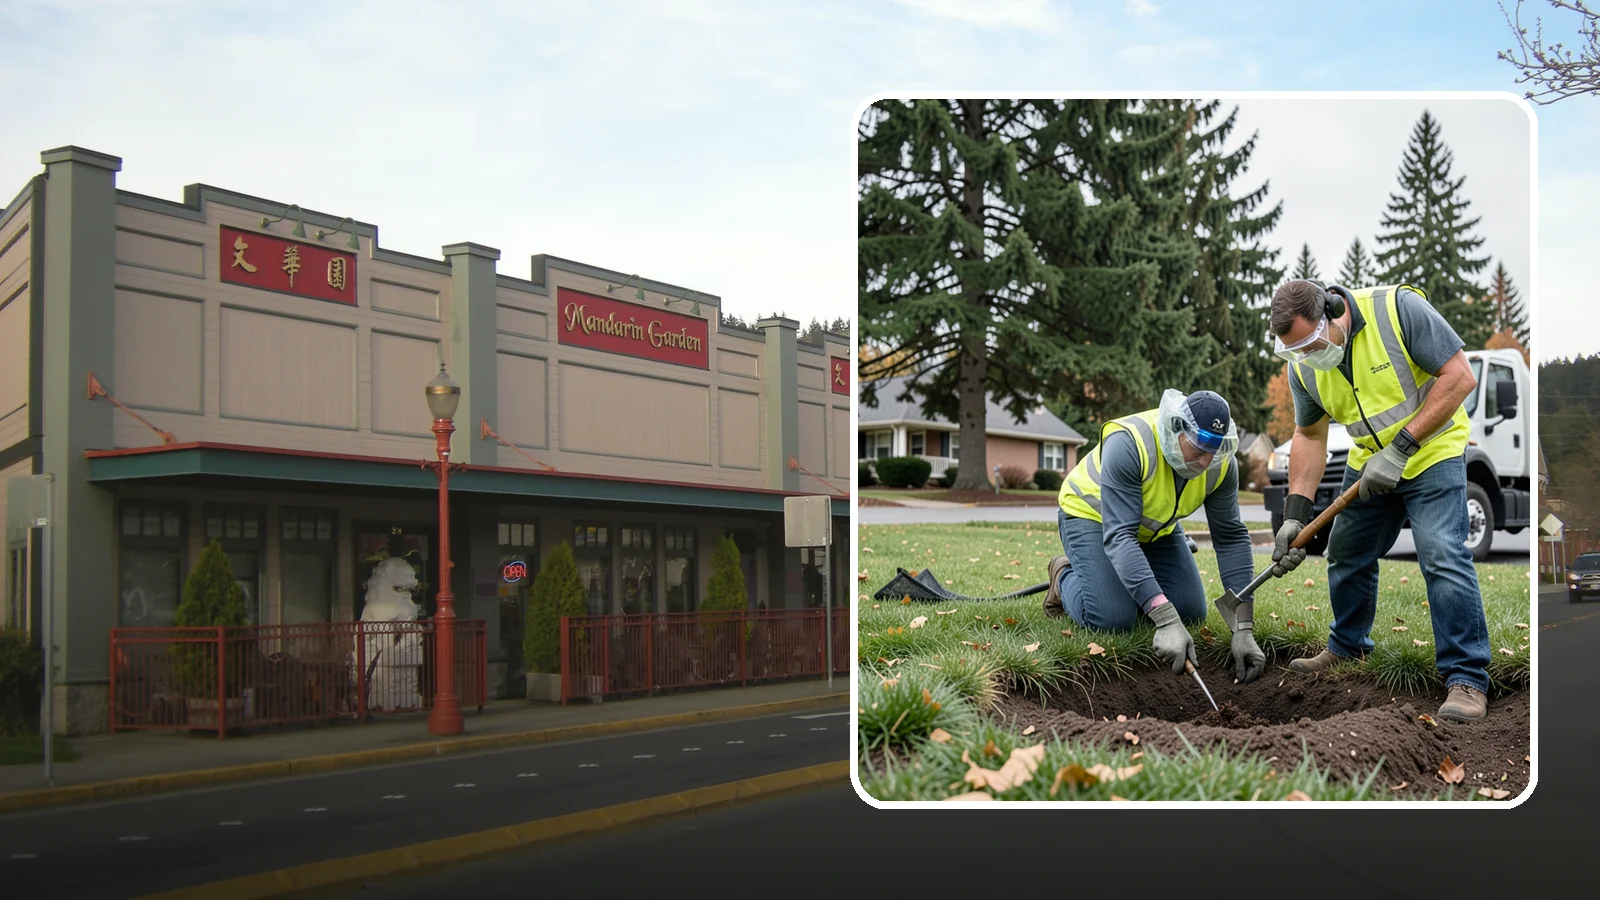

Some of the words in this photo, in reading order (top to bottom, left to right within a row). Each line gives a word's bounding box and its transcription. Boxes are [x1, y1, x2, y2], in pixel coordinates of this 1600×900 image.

[564, 302, 645, 341] Mandarin
[648, 320, 702, 352] Garden
[503, 565, 527, 578] OPEN
